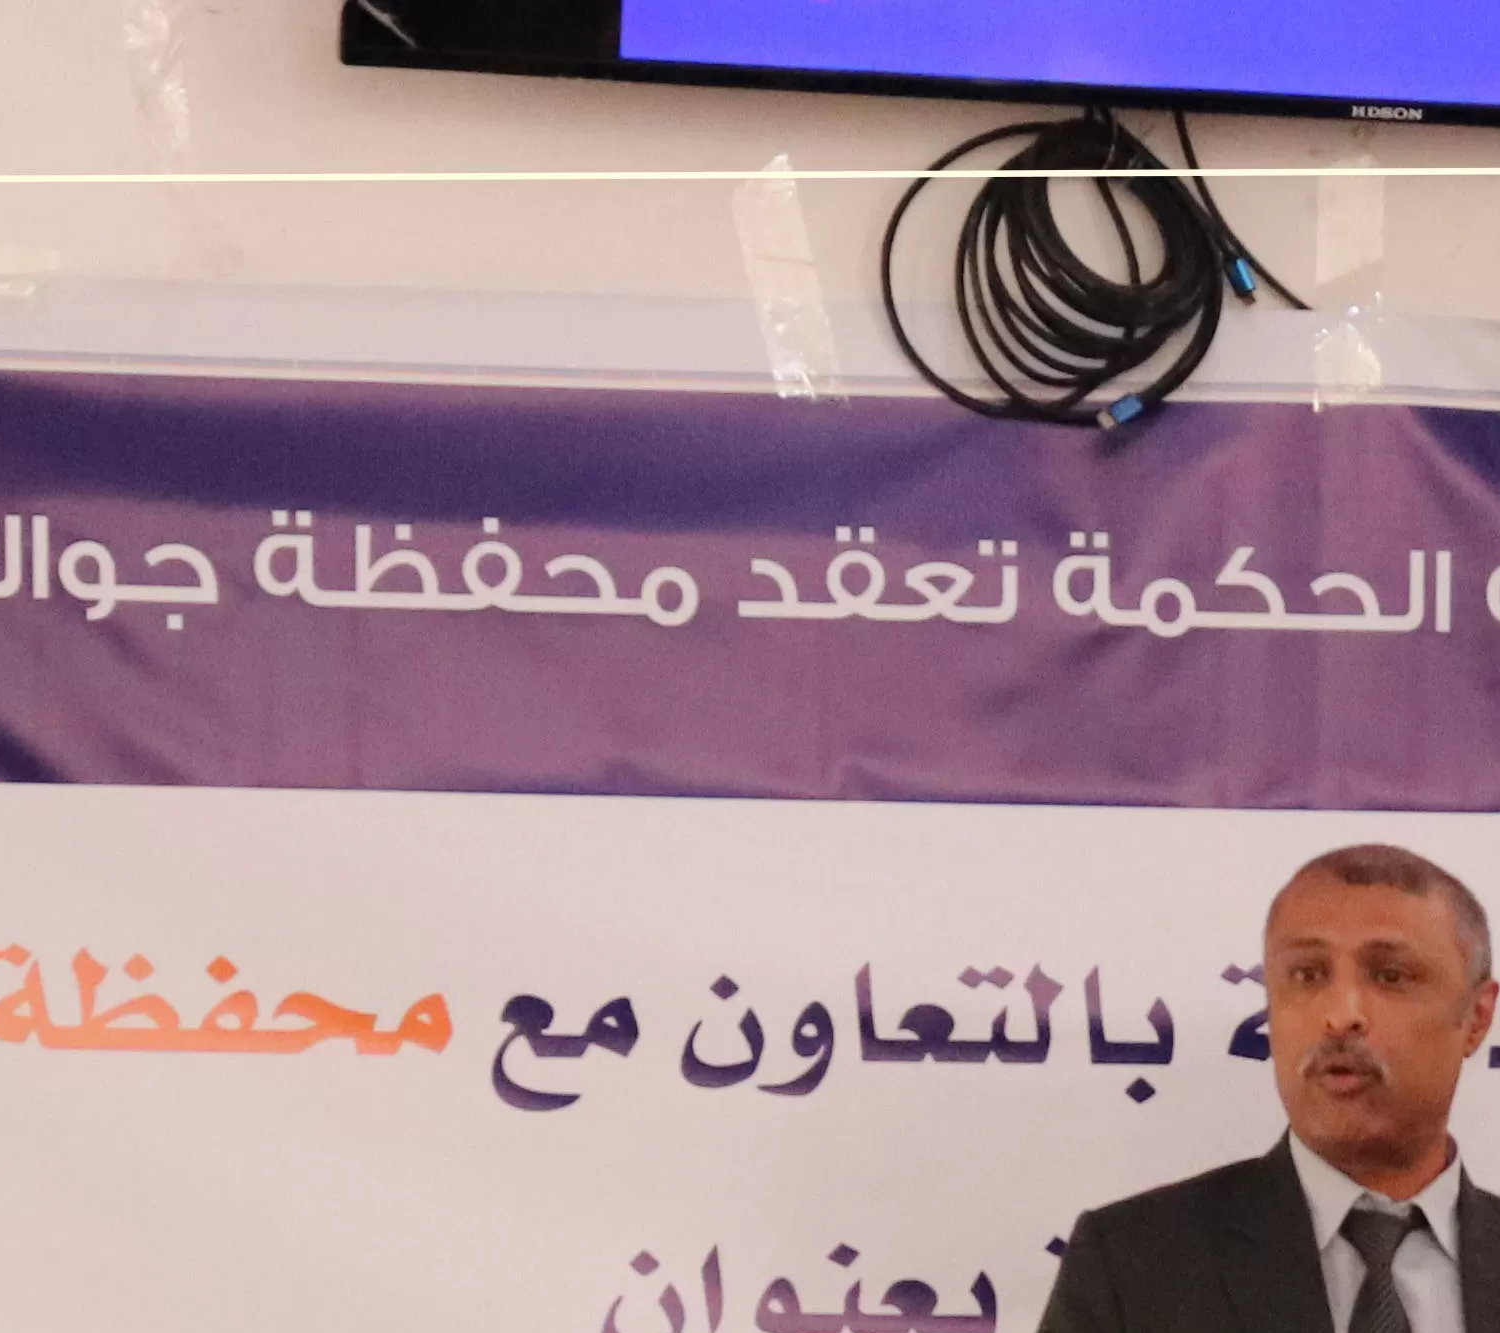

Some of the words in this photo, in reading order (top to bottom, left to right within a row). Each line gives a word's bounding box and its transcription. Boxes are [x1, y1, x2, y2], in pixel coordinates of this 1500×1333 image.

[253, 508, 701, 628] محفظة
[737, 526, 1020, 625] تعقد
[1052, 530, 1454, 640] الحكمة
[490, 993, 641, 1113] مع
[680, 960, 1176, 1106] بالتعاون
